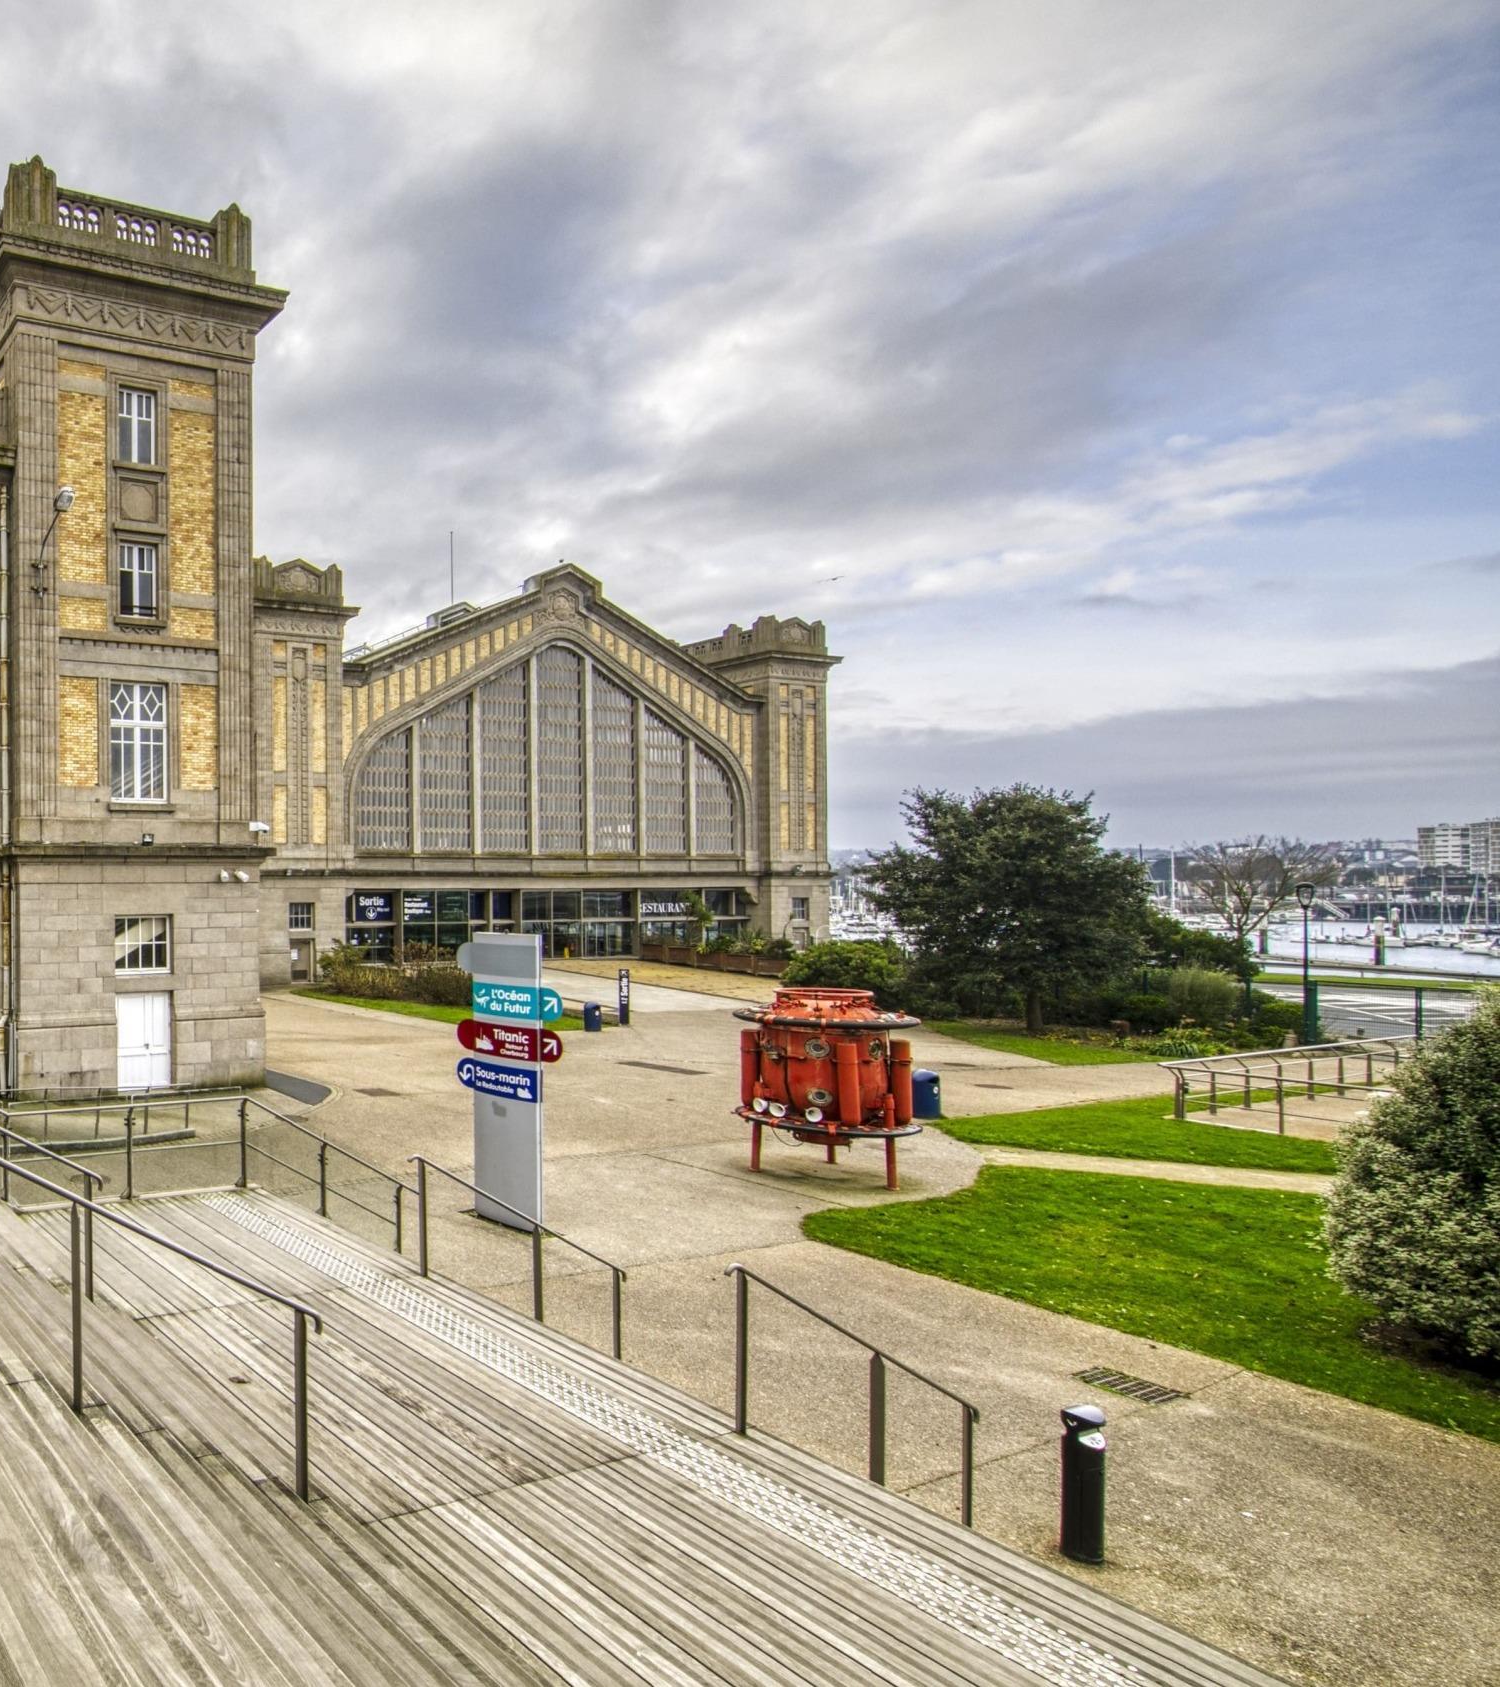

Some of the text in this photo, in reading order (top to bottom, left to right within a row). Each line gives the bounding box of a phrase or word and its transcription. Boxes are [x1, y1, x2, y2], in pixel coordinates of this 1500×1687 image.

[359, 896, 384, 906] Sortie
[491, 988, 531, 1002] L'Océan
[490, 1000, 532, 1014] du Futur
[492, 1028, 529, 1044] Titanic
[499, 1048, 529, 1059] Cherbourg
[476, 1066, 531, 1086] Sous-marin
[482, 1081, 514, 1094] Redoutable
